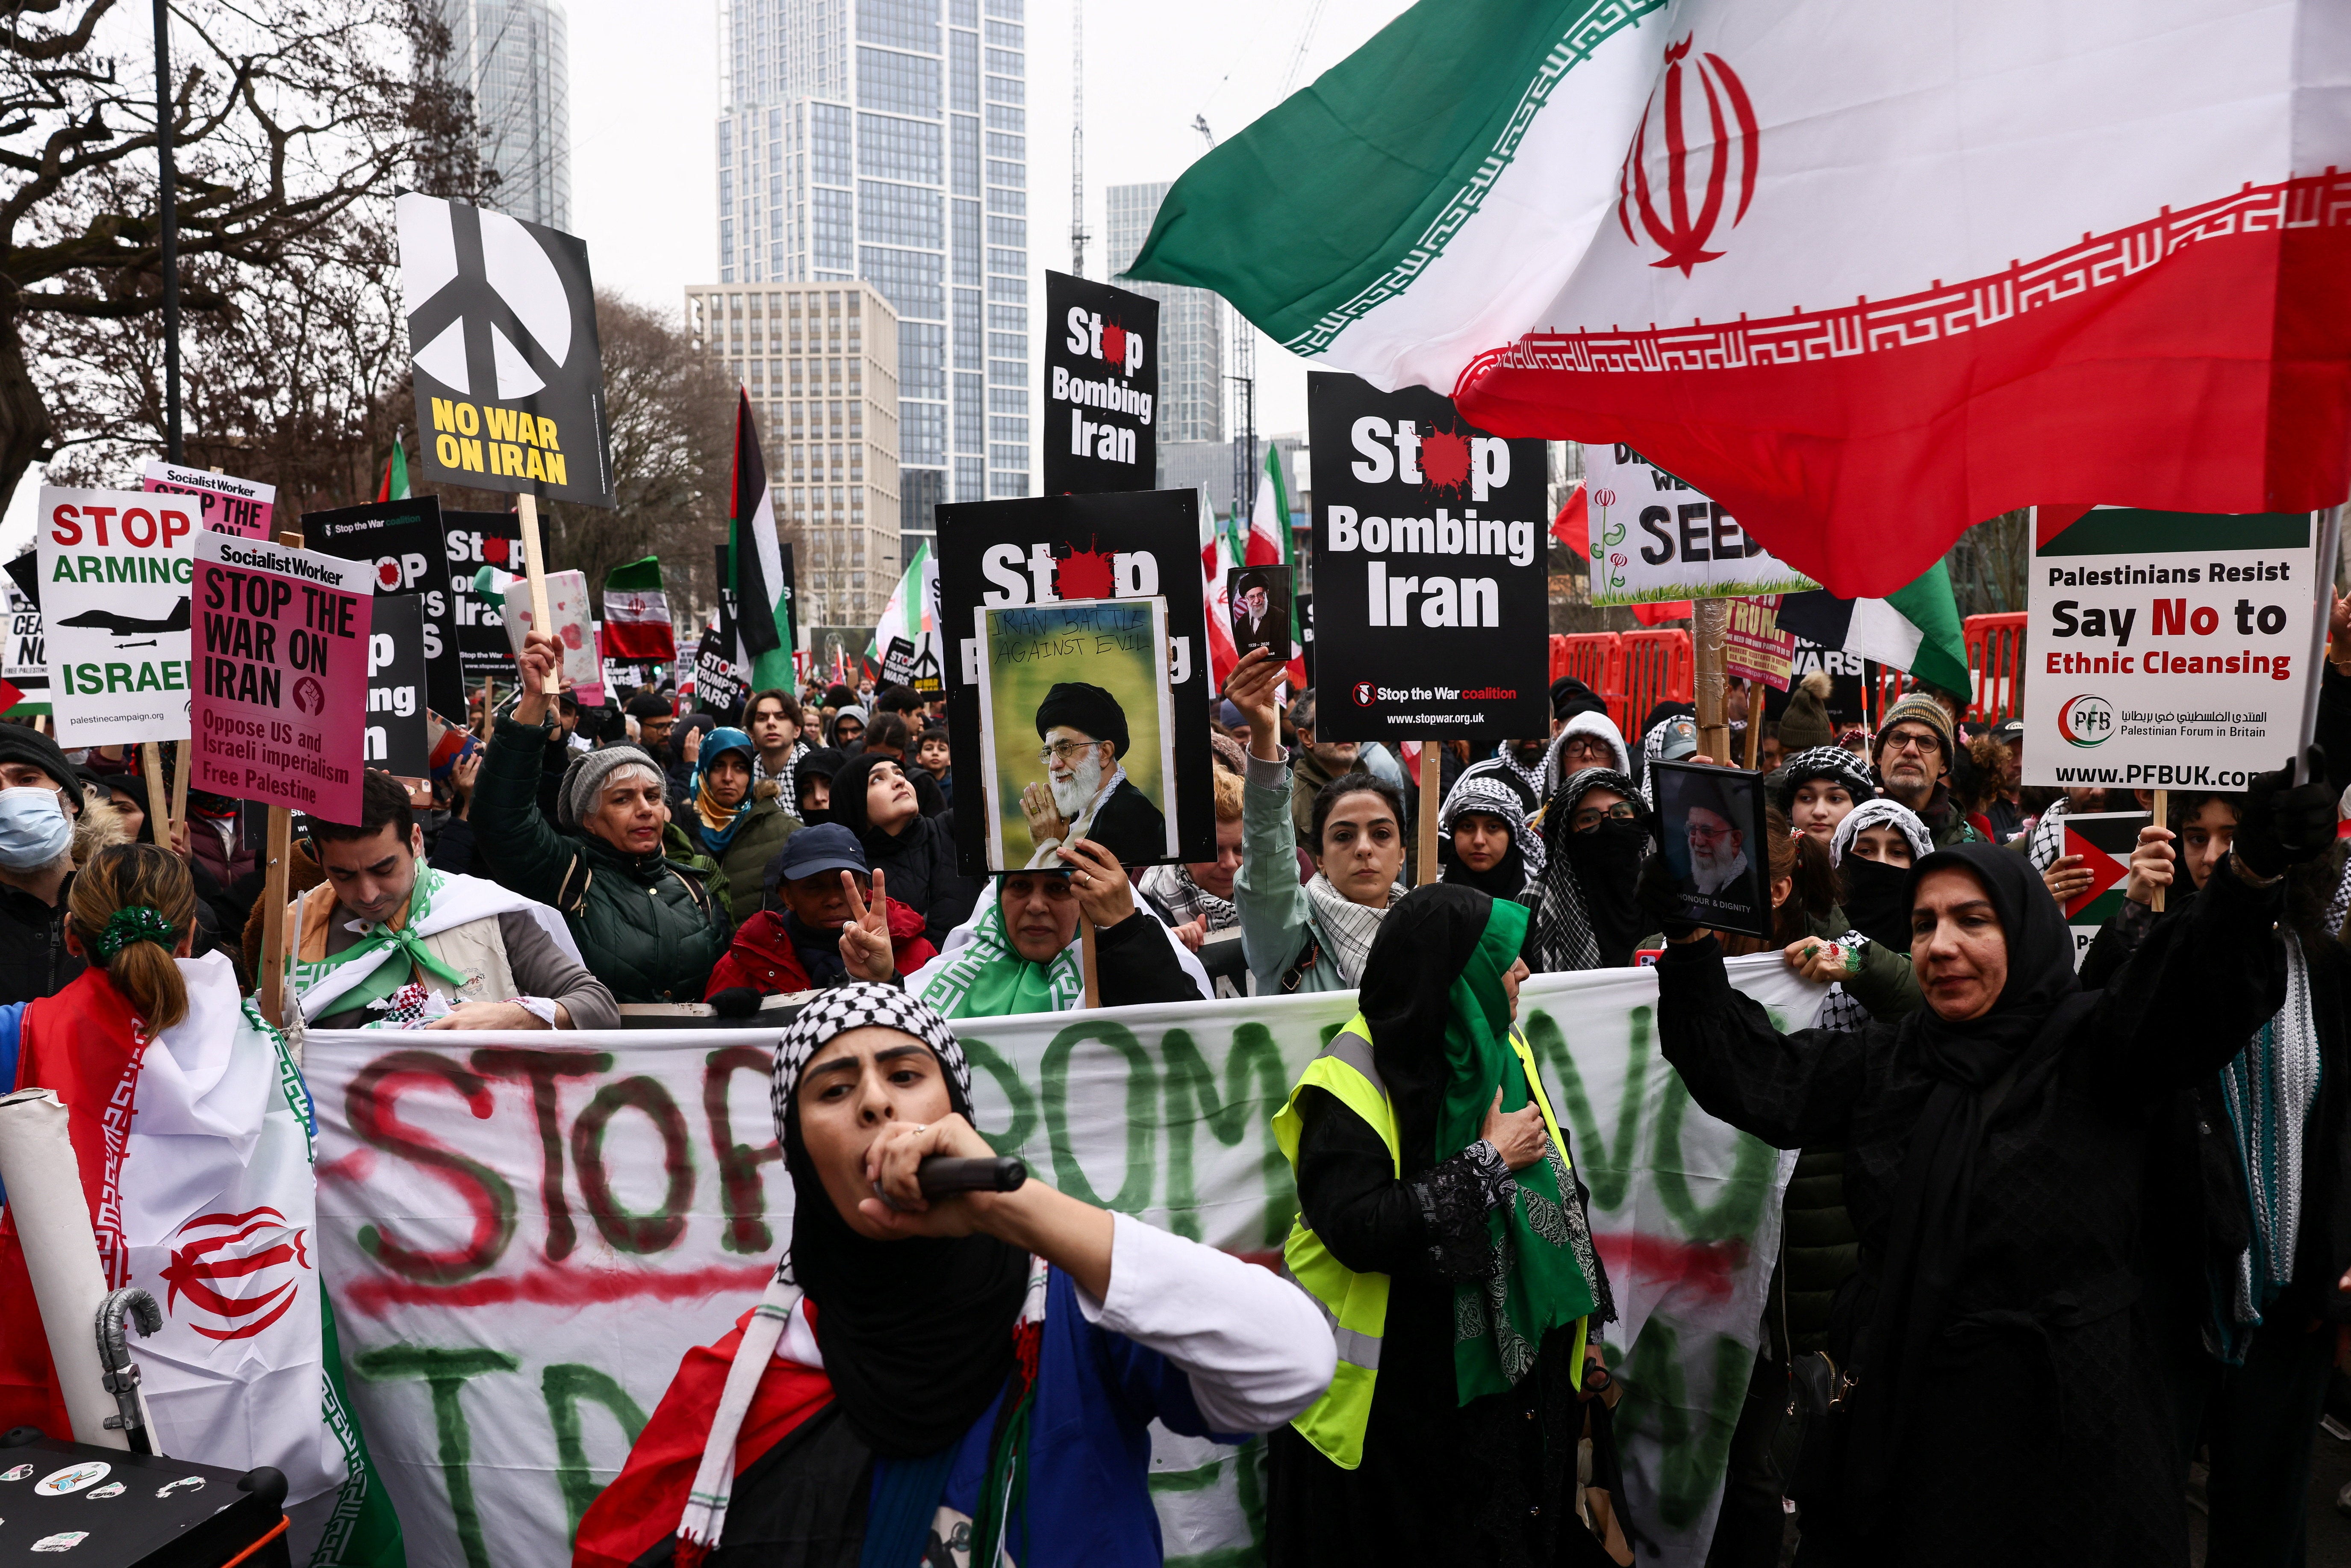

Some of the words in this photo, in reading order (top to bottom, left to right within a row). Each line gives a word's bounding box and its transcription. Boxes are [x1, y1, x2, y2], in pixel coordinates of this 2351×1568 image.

[1052, 366, 1152, 425] Bombing
[431, 397, 480, 436] NO
[483, 406, 560, 451] WAR
[1071, 410, 1135, 464] Iran
[436, 433, 483, 473] ON
[488, 442, 567, 486] IRAN
[167, 470, 216, 489] Socialist
[217, 480, 255, 497] Worker
[52, 504, 190, 548] STOP
[223, 497, 261, 528] THE
[335, 524, 353, 534] Stop
[354, 521, 367, 530] the
[368, 519, 384, 528] War
[386, 515, 421, 526] coalition
[1328, 506, 1535, 566] Bombing
[53, 556, 192, 584] ARMING
[220, 544, 291, 573] Socialist
[292, 561, 343, 585] Worker
[2049, 564, 2201, 587] Palestinians
[2209, 561, 2290, 583] Resist
[205, 567, 292, 621] STOP
[301, 586, 357, 639] THE
[1368, 561, 1500, 628] Iran
[456, 595, 504, 625] Ira
[988, 608, 1047, 637] IRAN
[1063, 609, 1149, 635] BATTLE
[2052, 599, 2136, 646] Say
[2152, 598, 2219, 636] No
[2235, 599, 2286, 635] to
[204, 611, 276, 663] WAR
[289, 629, 328, 677] ON
[460, 651, 476, 660] Stop
[994, 638, 1085, 664] AGAINST
[1095, 634, 1150, 654] EVIL
[1734, 635, 1744, 643] NEED
[1753, 640, 1762, 648] OWN
[1763, 643, 1776, 651] PARTY
[1749, 651, 1771, 662] RESISTANCE
[701, 651, 738, 678] STOP
[890, 650, 915, 667] STOP
[2046, 651, 2134, 674] Ethnic
[2143, 651, 2291, 680] Cleansing
[204, 655, 280, 709] IRAN
[697, 665, 738, 695] TRUMP'S
[883, 668, 909, 686] WARS
[1377, 687, 1409, 703] Stop
[1411, 687, 1432, 699] the
[1435, 687, 1459, 699] War
[1462, 687, 1517, 699] coalition
[70, 712, 164, 725] palestinecampaign.org
[1387, 713, 1485, 725] www.stopwar.org.uk
[2074, 711, 2110, 731] PFB
[2121, 710, 2153, 723] بريطانيا
[2121, 725, 2176, 737] Palestinian
[2181, 726, 2213, 736] Forum
[2216, 726, 2226, 736] in
[2230, 726, 2265, 737] Britain
[2155, 710, 2174, 723] في
[2176, 711, 2230, 724] الفلسطيني
[2232, 711, 2267, 723] المنتدى
[203, 709, 265, 739] Oppose
[271, 722, 292, 744] US
[298, 730, 321, 754] and
[203, 732, 256, 760] Israeli
[262, 743, 349, 784] imperialism
[203, 760, 238, 786] Free
[245, 771, 316, 804] Palestine
[1677, 893, 1709, 906] HONOUR
[1720, 901, 1750, 913] DIGNITY
